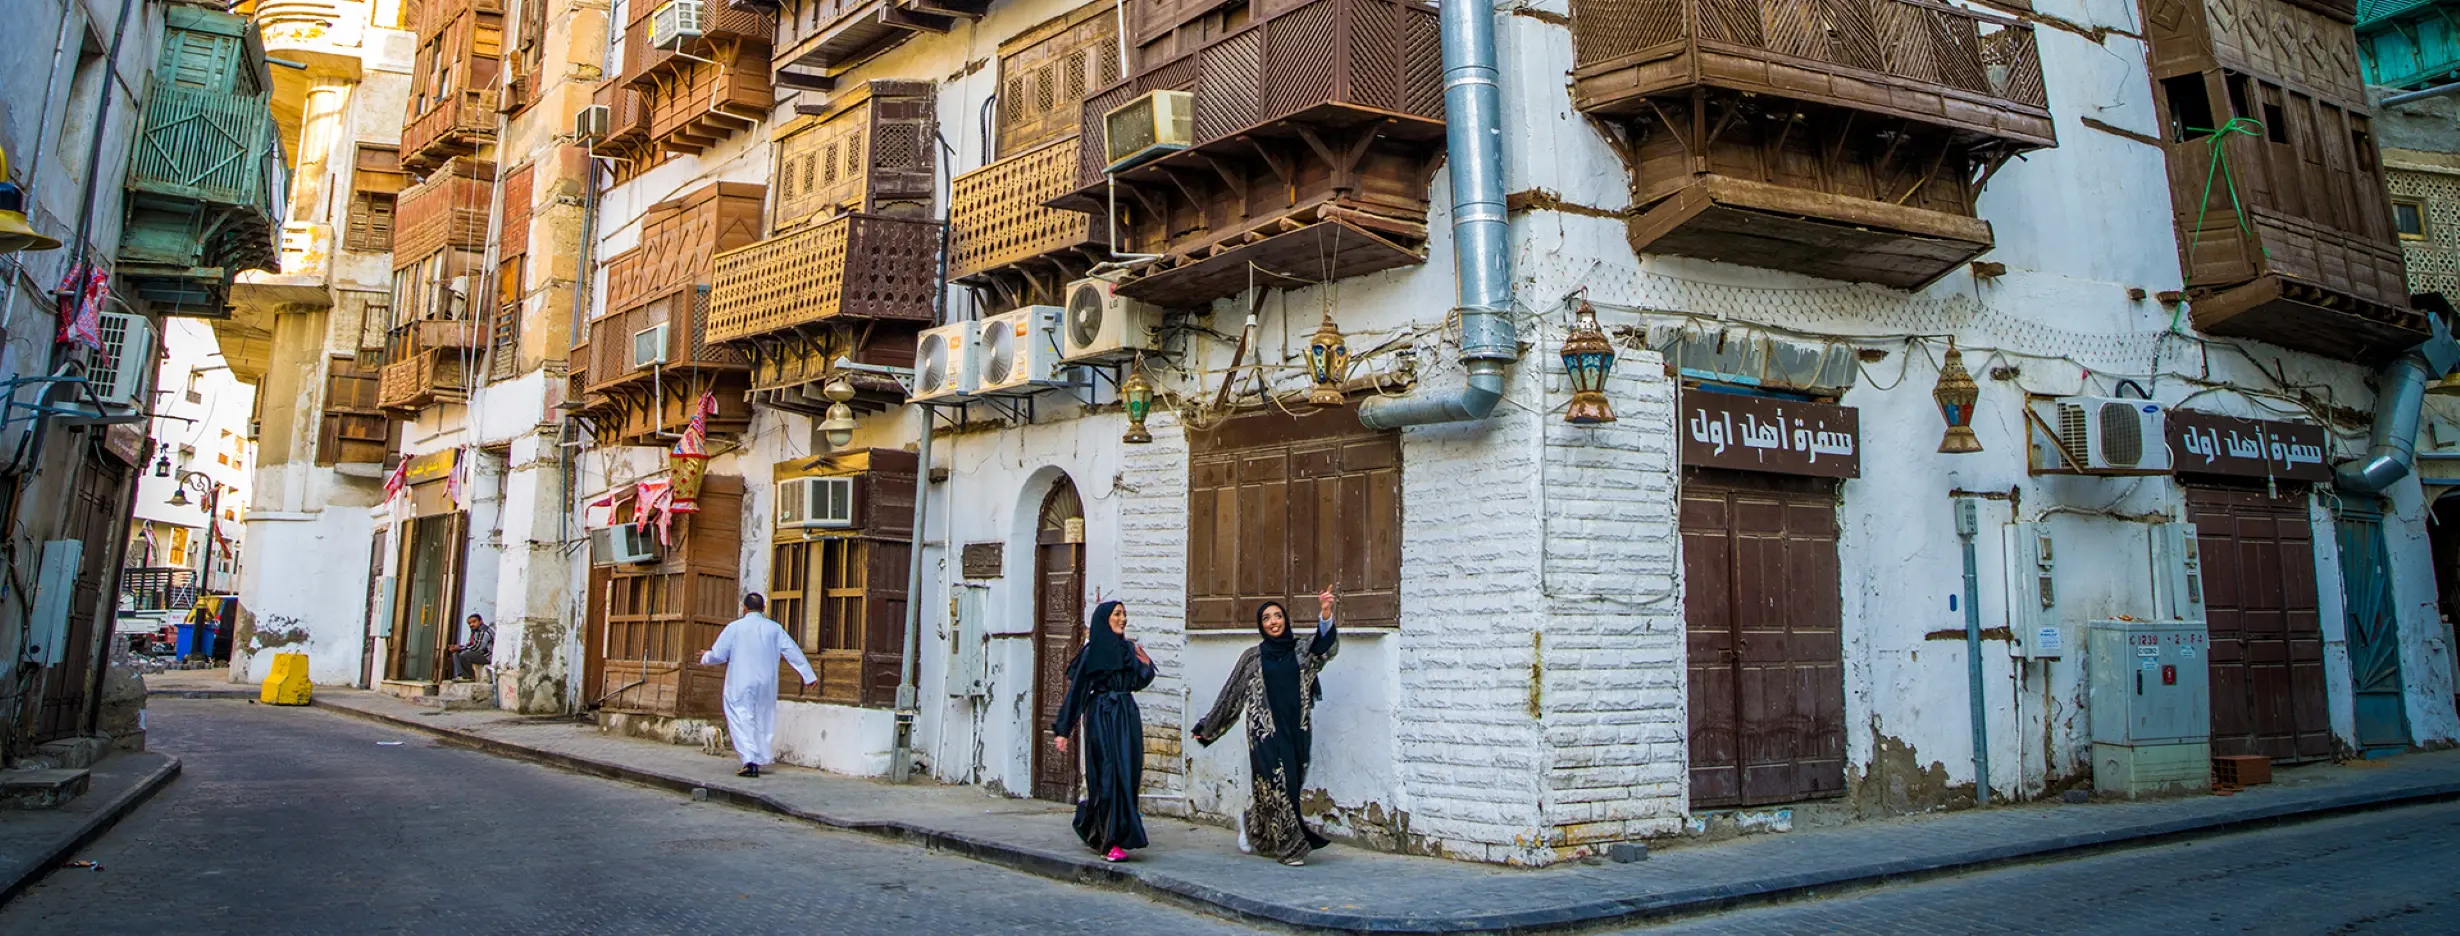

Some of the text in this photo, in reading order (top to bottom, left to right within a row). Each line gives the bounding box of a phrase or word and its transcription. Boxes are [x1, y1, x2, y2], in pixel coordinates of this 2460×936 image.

[1690, 408, 1734, 457] اول
[1794, 418, 1853, 464] سفرة
[2183, 425, 2221, 465] اول
[2270, 433, 2323, 471] سفرة
